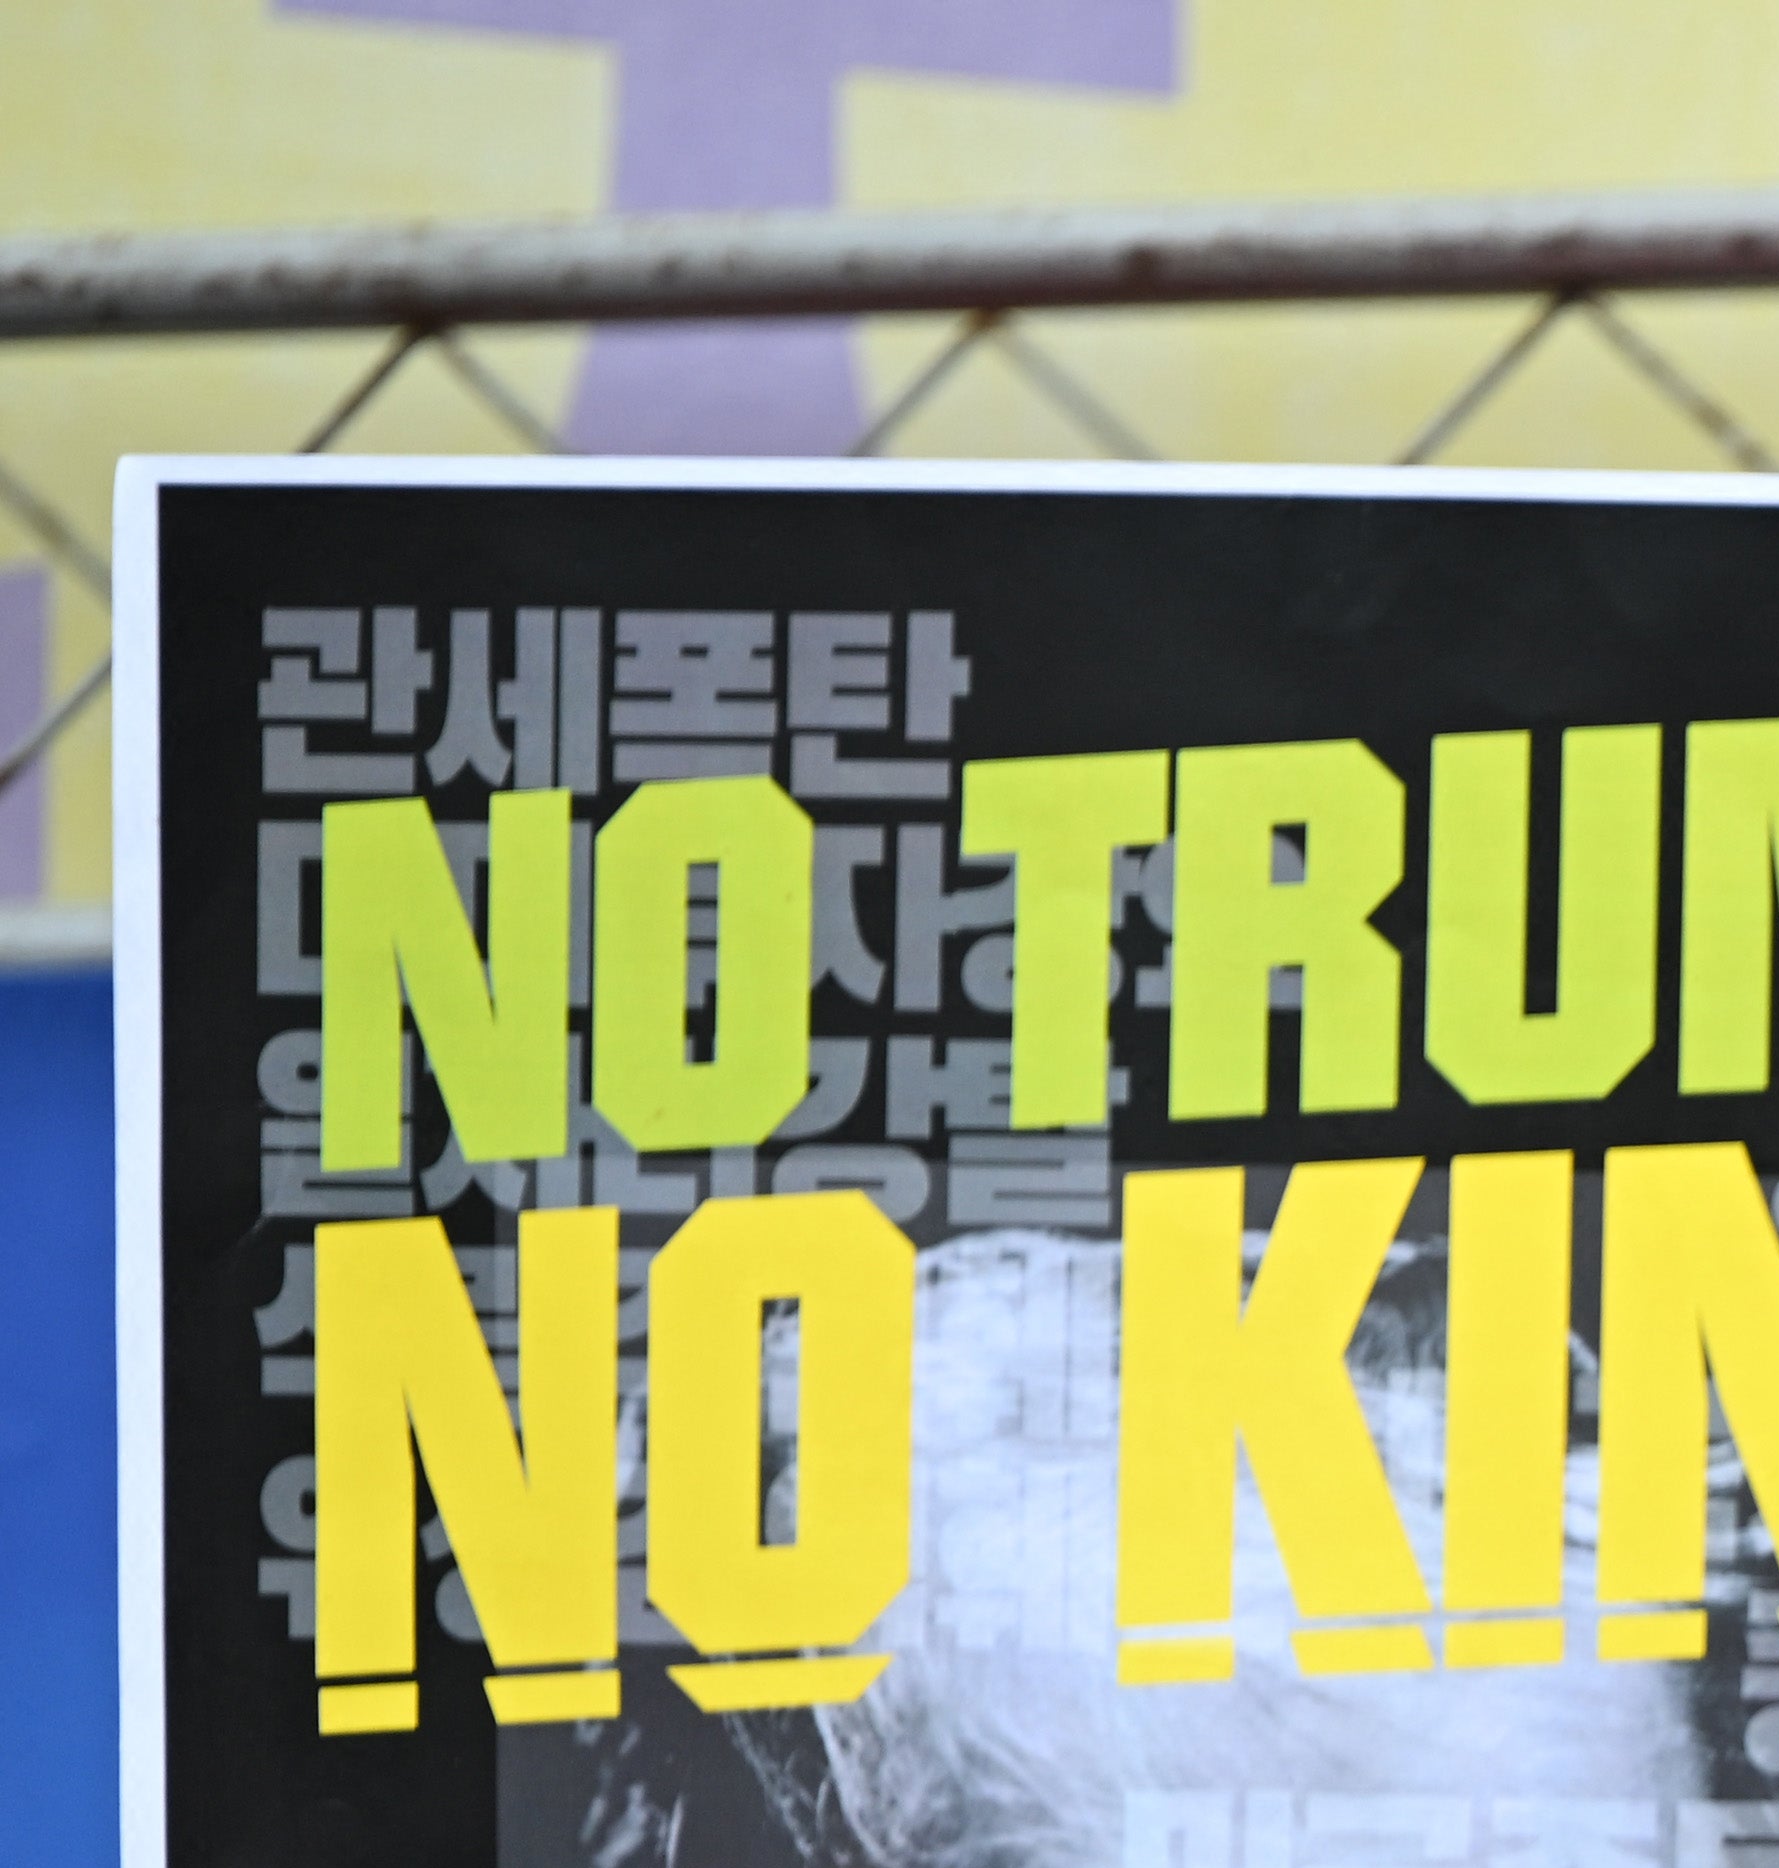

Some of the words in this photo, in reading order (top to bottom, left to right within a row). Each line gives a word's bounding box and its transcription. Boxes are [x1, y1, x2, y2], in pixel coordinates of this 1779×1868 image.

[257, 606, 971, 797] 관세폭탄
[322, 776, 814, 1171] NO
[314, 1189, 918, 1736] NO
